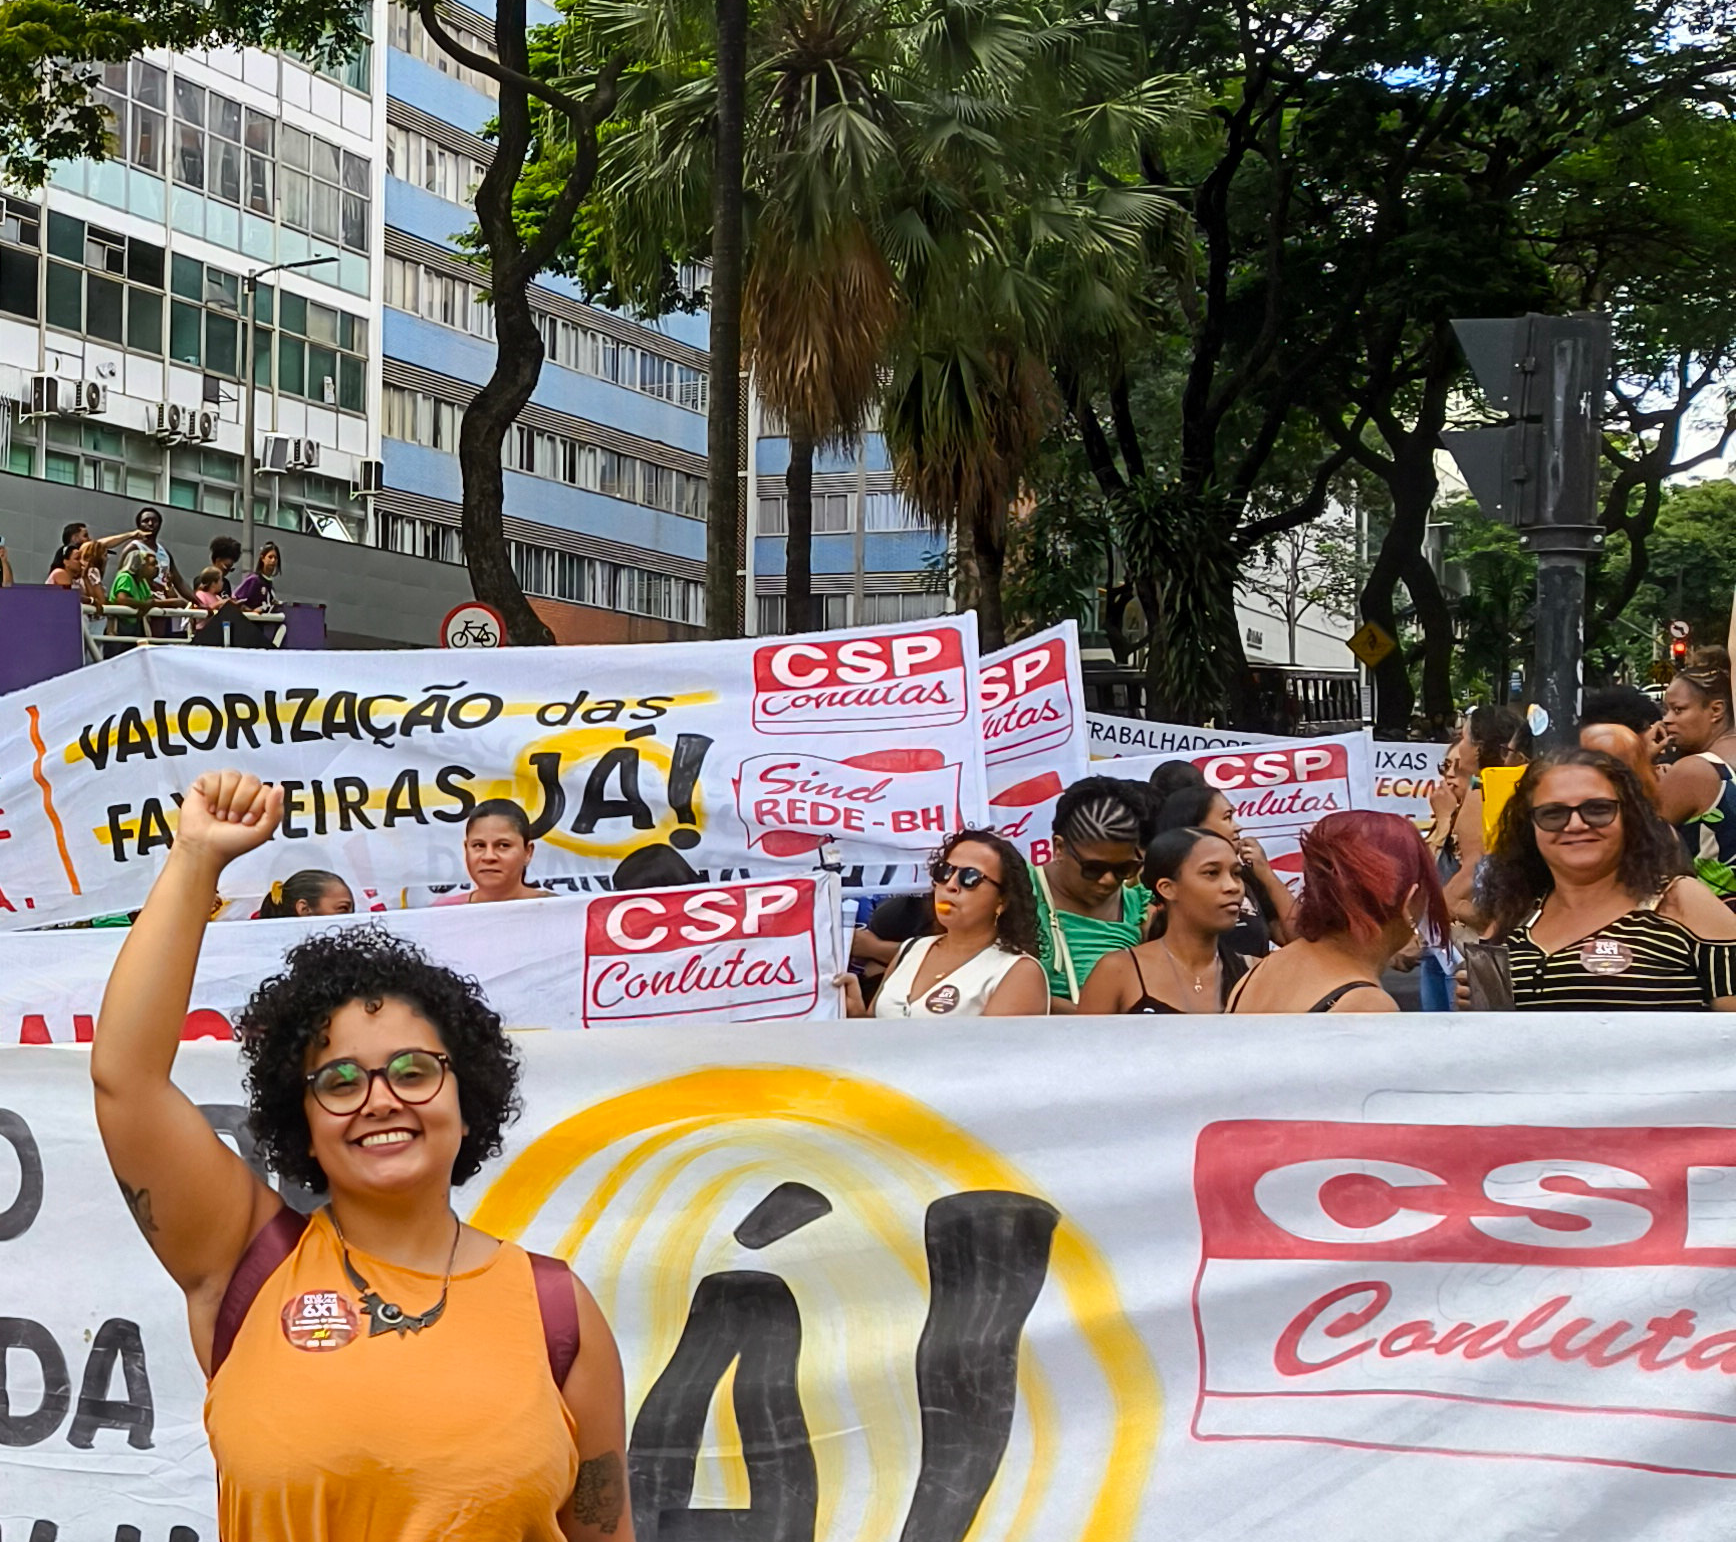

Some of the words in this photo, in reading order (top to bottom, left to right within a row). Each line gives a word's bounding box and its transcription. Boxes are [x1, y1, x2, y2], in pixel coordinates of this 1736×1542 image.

[771, 635, 943, 688] CSP
[980, 649, 1051, 709] SP
[79, 681, 504, 770] VALORIZAÇÃO
[536, 690, 675, 727] das
[758, 761, 894, 803] Sind
[1203, 749, 1333, 790] CSP
[1375, 750, 1428, 771] IXAS
[1375, 776, 1438, 799] ECI
[107, 764, 477, 863] FAEIRAS
[526, 724, 715, 850] JÁ!
[1235, 788, 1343, 818] nlutas
[606, 884, 797, 951] CSP
[591, 948, 803, 1009] Conlutas
[1253, 1158, 1736, 1249] CS
[1274, 1281, 1736, 1377] Conluta
